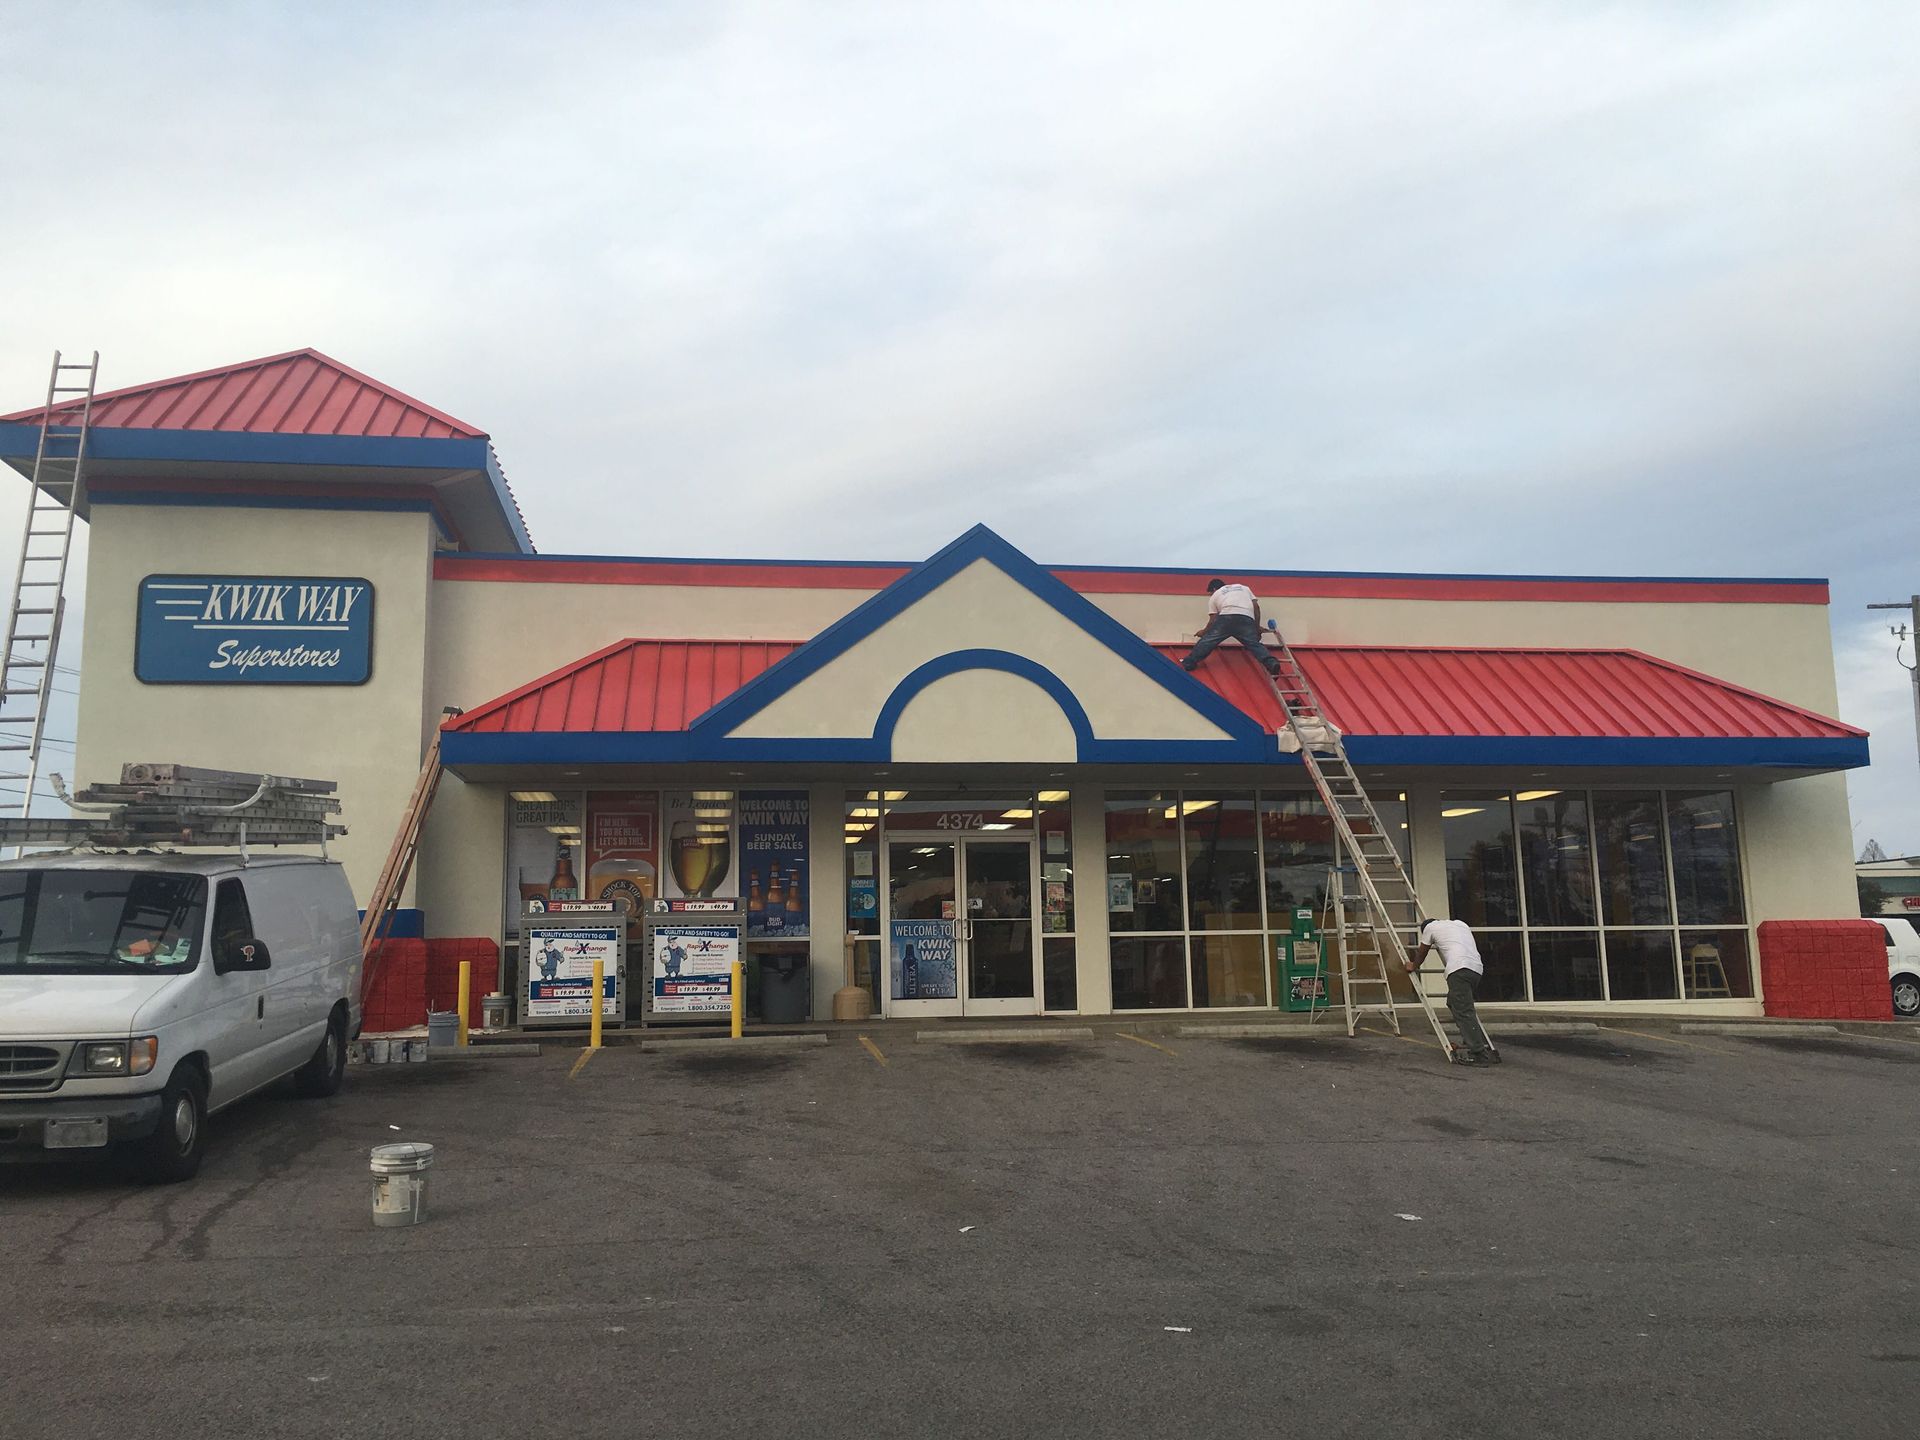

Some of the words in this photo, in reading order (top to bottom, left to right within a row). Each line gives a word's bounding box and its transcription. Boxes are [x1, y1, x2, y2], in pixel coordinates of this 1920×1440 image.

[202, 585, 292, 620] KWIK
[298, 586, 363, 622] WAY
[208, 640, 340, 674] Superstores
[516, 800, 546, 810] GREAT
[740, 800, 791, 810] WELCOME
[795, 800, 808, 810] TO
[516, 812, 547, 822] GREAT
[550, 812, 568, 822] IPA.
[740, 812, 775, 824] KWIK
[779, 812, 808, 824] WAY
[936, 814, 984, 829] 4374
[602, 881, 626, 900] SHOCK
[628, 884, 640, 898] TOP
[895, 926, 938, 936] WELCOME
[941, 926, 951, 936] TO
[918, 940, 952, 949] KWIK
[921, 950, 949, 960] WAY
